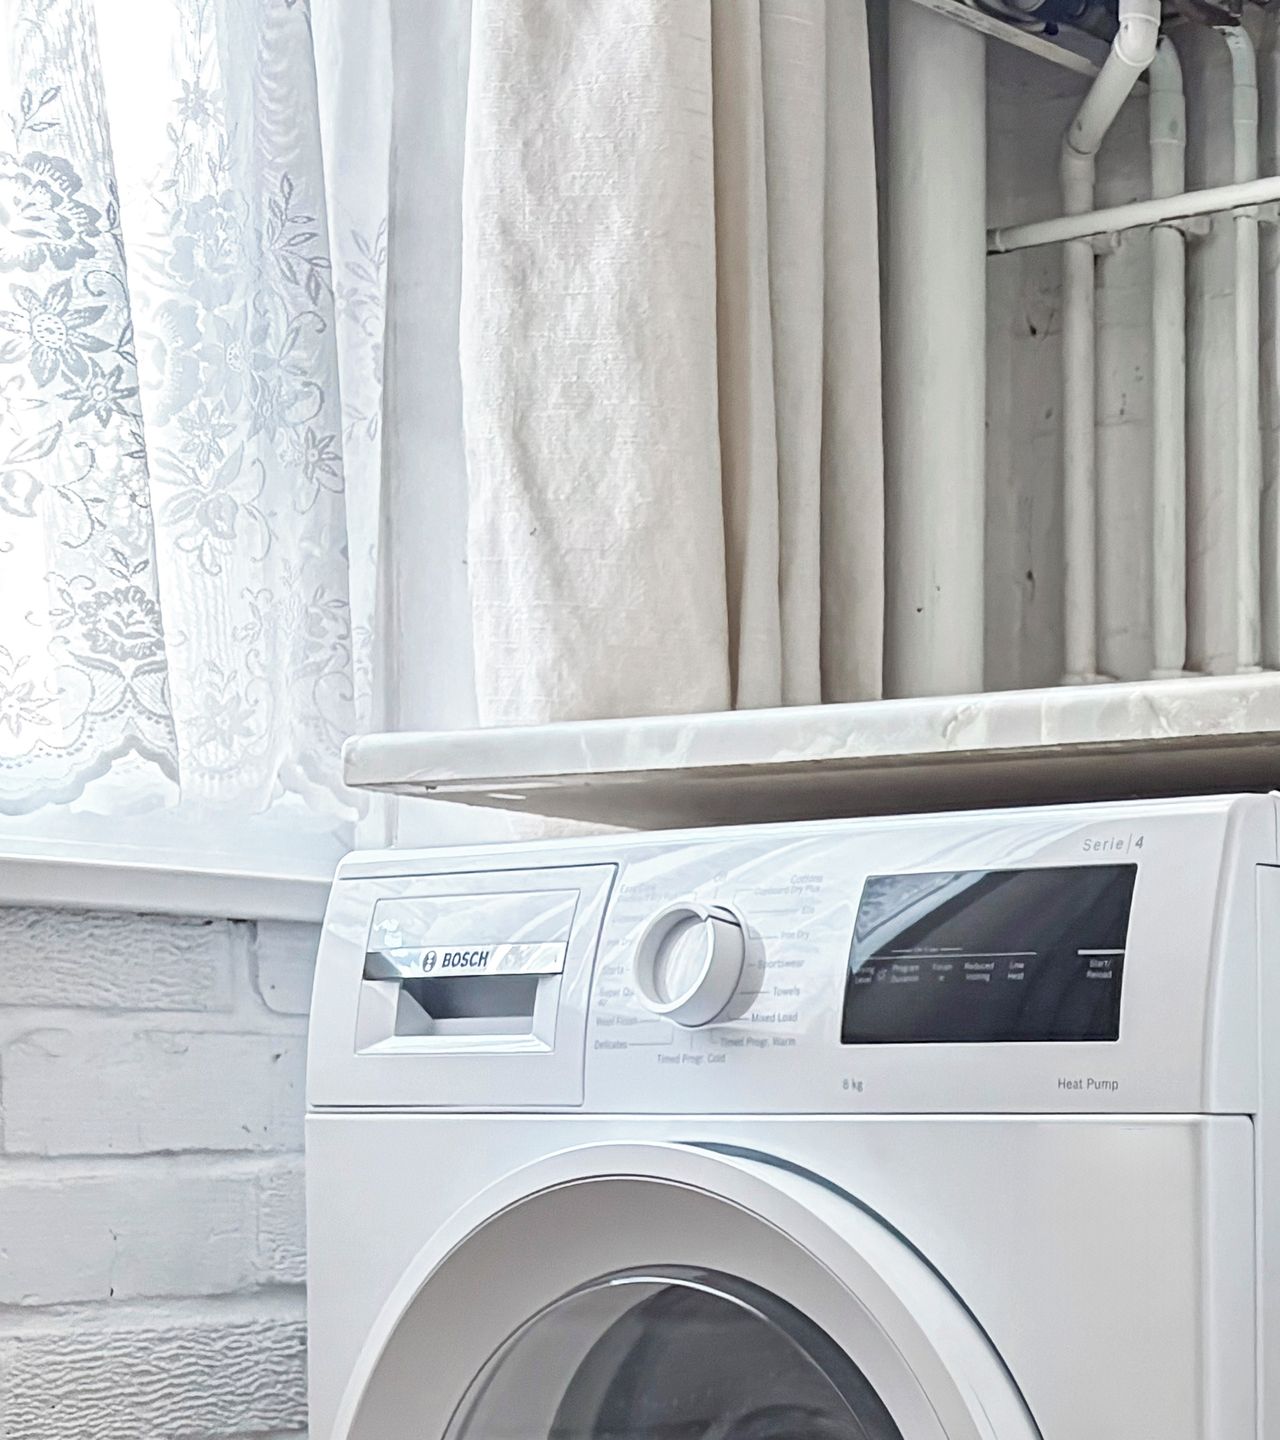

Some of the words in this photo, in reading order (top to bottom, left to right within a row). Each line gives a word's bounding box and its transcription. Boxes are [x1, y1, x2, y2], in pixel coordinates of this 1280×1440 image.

[1082, 838, 1124, 851] Serie
[1135, 836, 1144, 849] 4
[441, 950, 489, 969] BOSCH
[773, 987, 800, 996] Towels
[752, 1013, 776, 1023] Mixed
[778, 1013, 798, 1022] Load
[773, 1037, 796, 1046] Warm
[851, 1079, 863, 1093] kg
[1057, 1077, 1083, 1090] Heat
[1086, 1077, 1119, 1092] Pump
